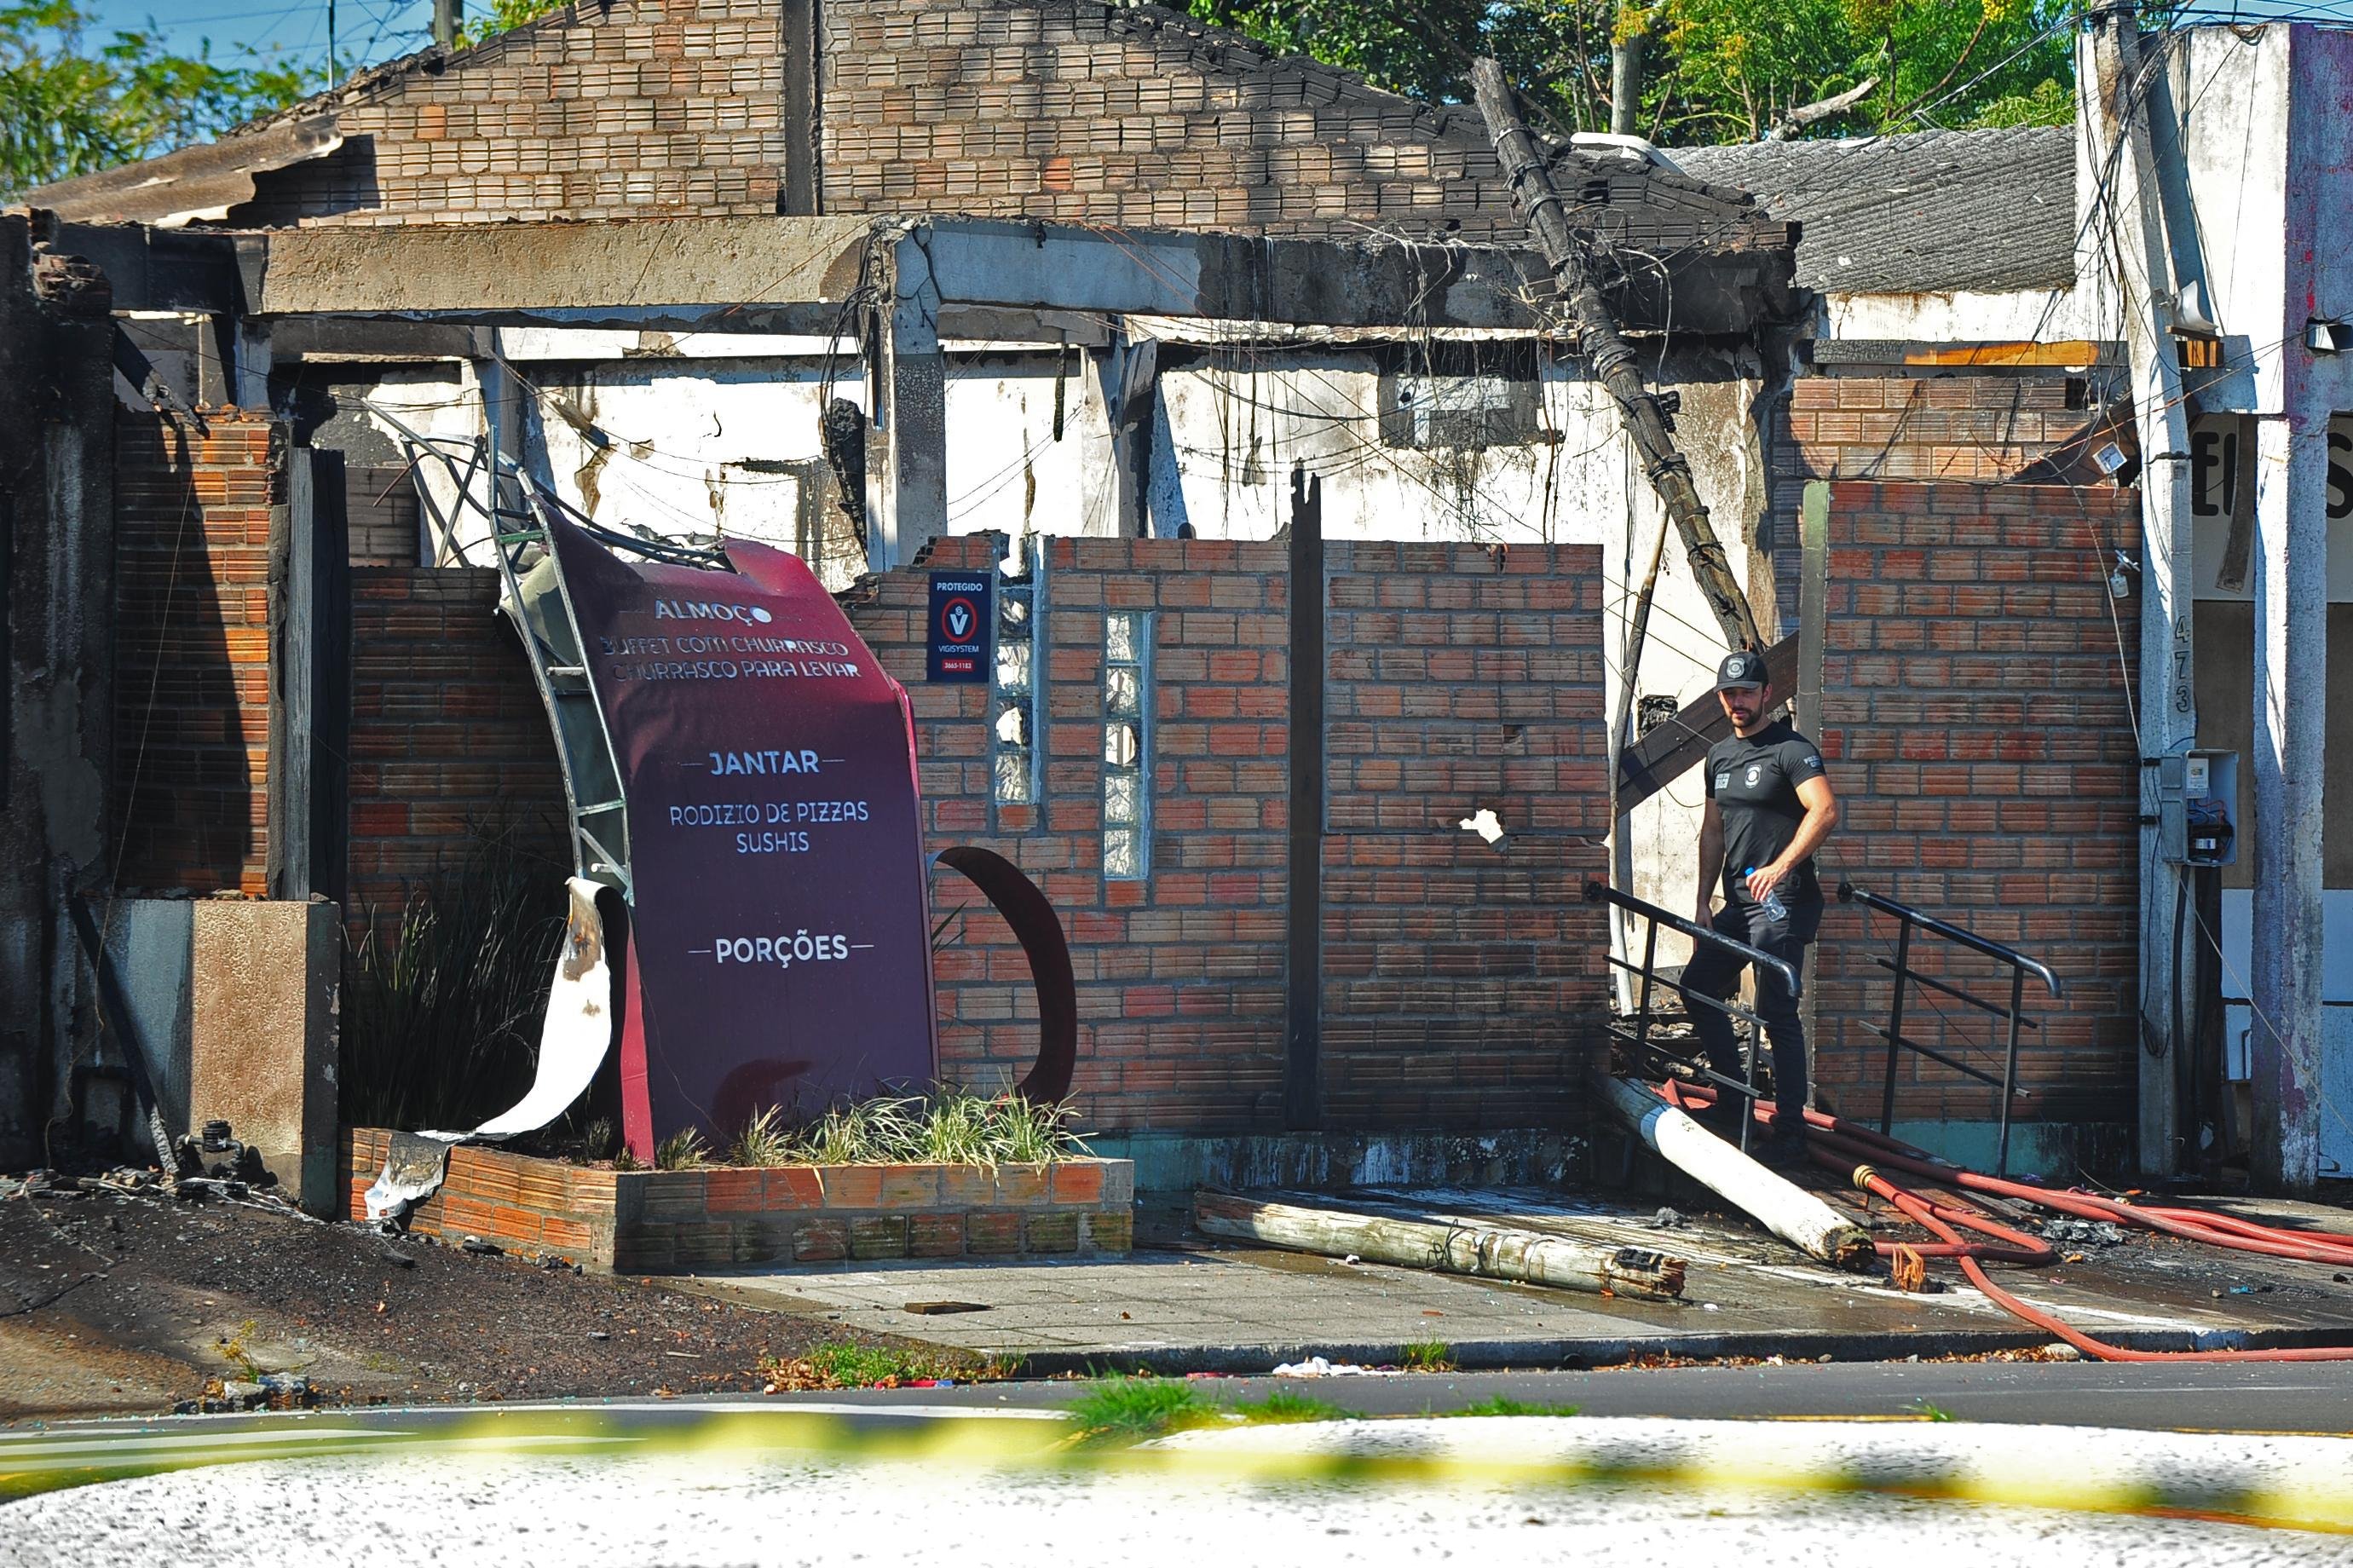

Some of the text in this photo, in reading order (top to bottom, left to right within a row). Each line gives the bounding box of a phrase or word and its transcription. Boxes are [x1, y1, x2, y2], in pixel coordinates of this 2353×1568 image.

[936, 582, 983, 592] PROTEGIDO
[655, 599, 772, 627] ALMOÇO
[600, 636, 850, 656] BUFFET COM CHURRASCO
[937, 644, 980, 653] VIGISYSTEM
[613, 660, 862, 682] CHURRASCO PARA LEVAR
[709, 750, 820, 775] JANTAR
[669, 801, 868, 826] RODIZIO DE PIZZAS
[736, 832, 810, 853] SUSHIS
[715, 929, 848, 969] PORÇÕES
